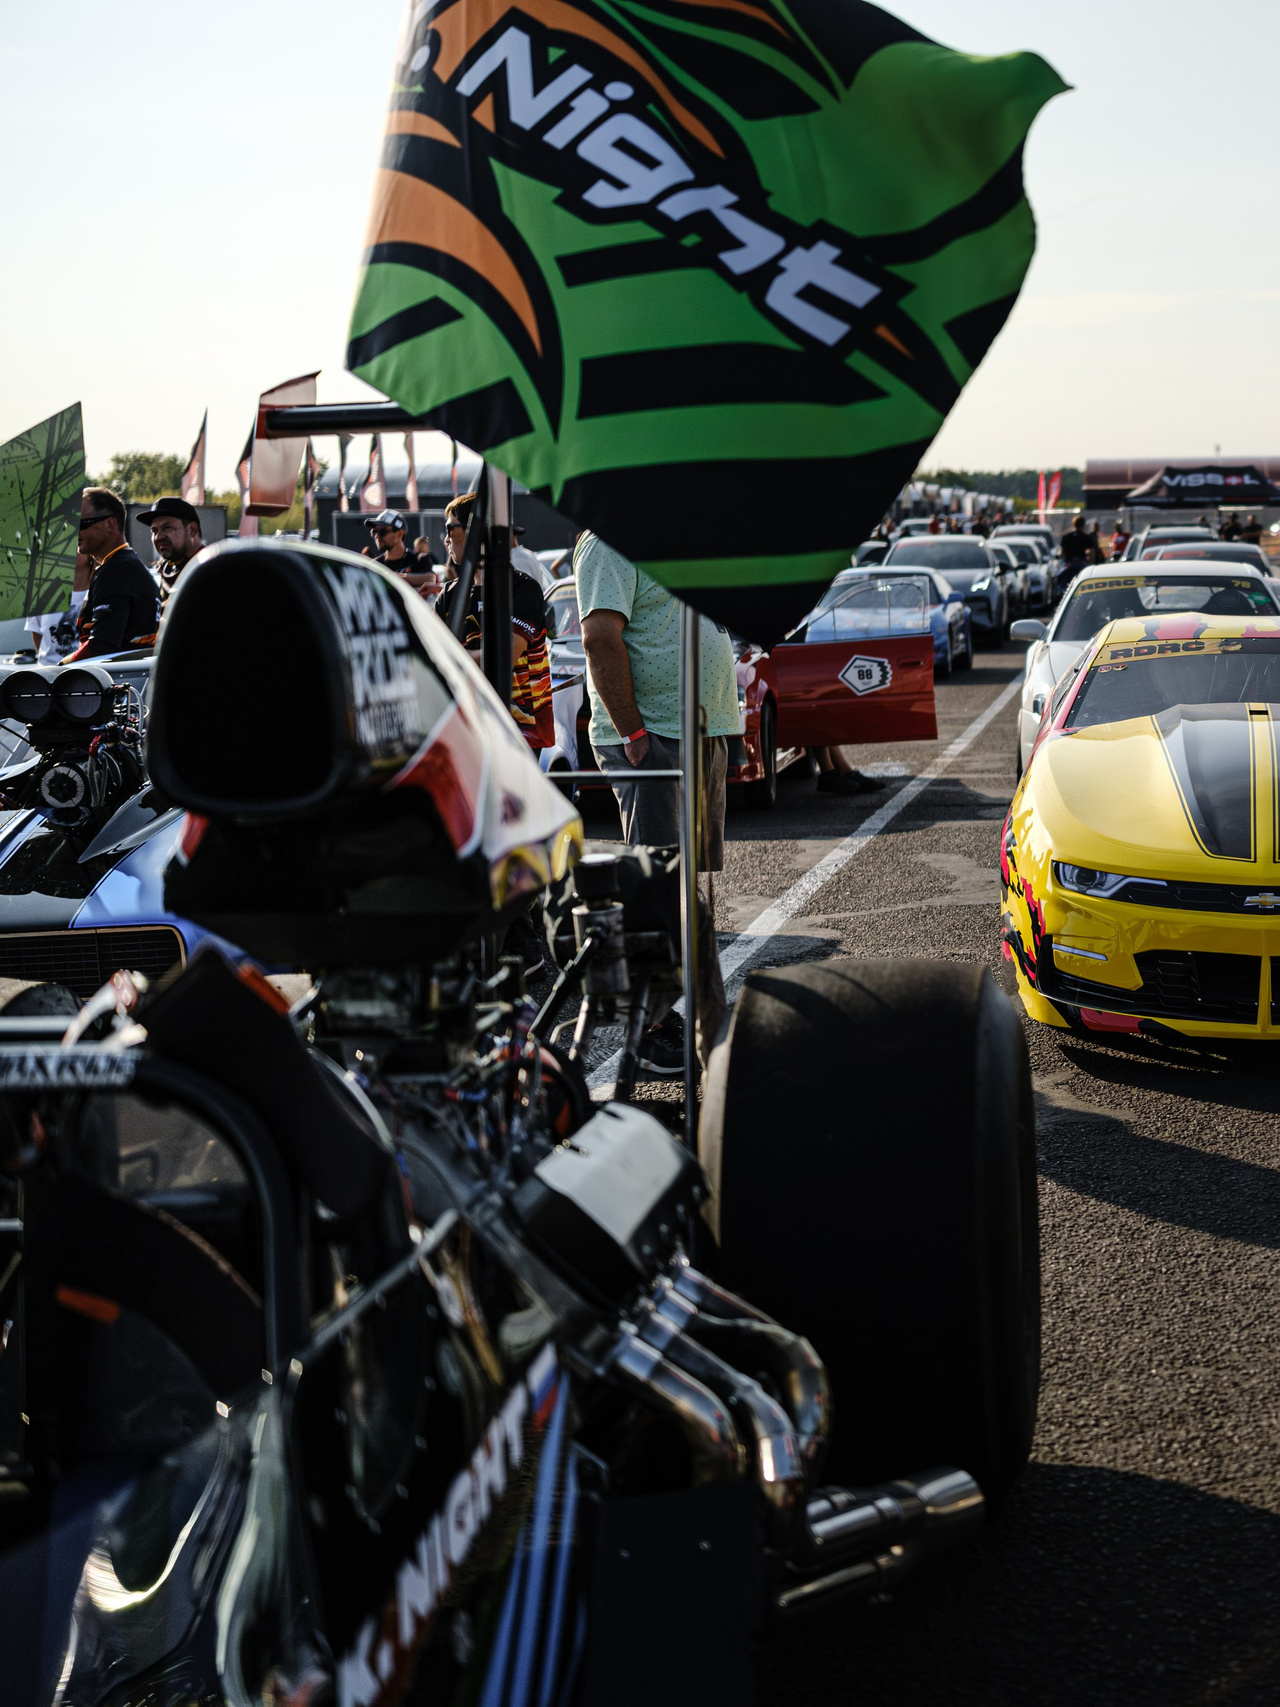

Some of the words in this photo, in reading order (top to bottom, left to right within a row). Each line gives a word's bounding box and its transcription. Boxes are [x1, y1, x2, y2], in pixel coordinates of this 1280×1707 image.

[1080, 578, 1137, 592] RDRC
[1109, 640, 1205, 661] RDRC
[857, 668, 873, 681] 88
